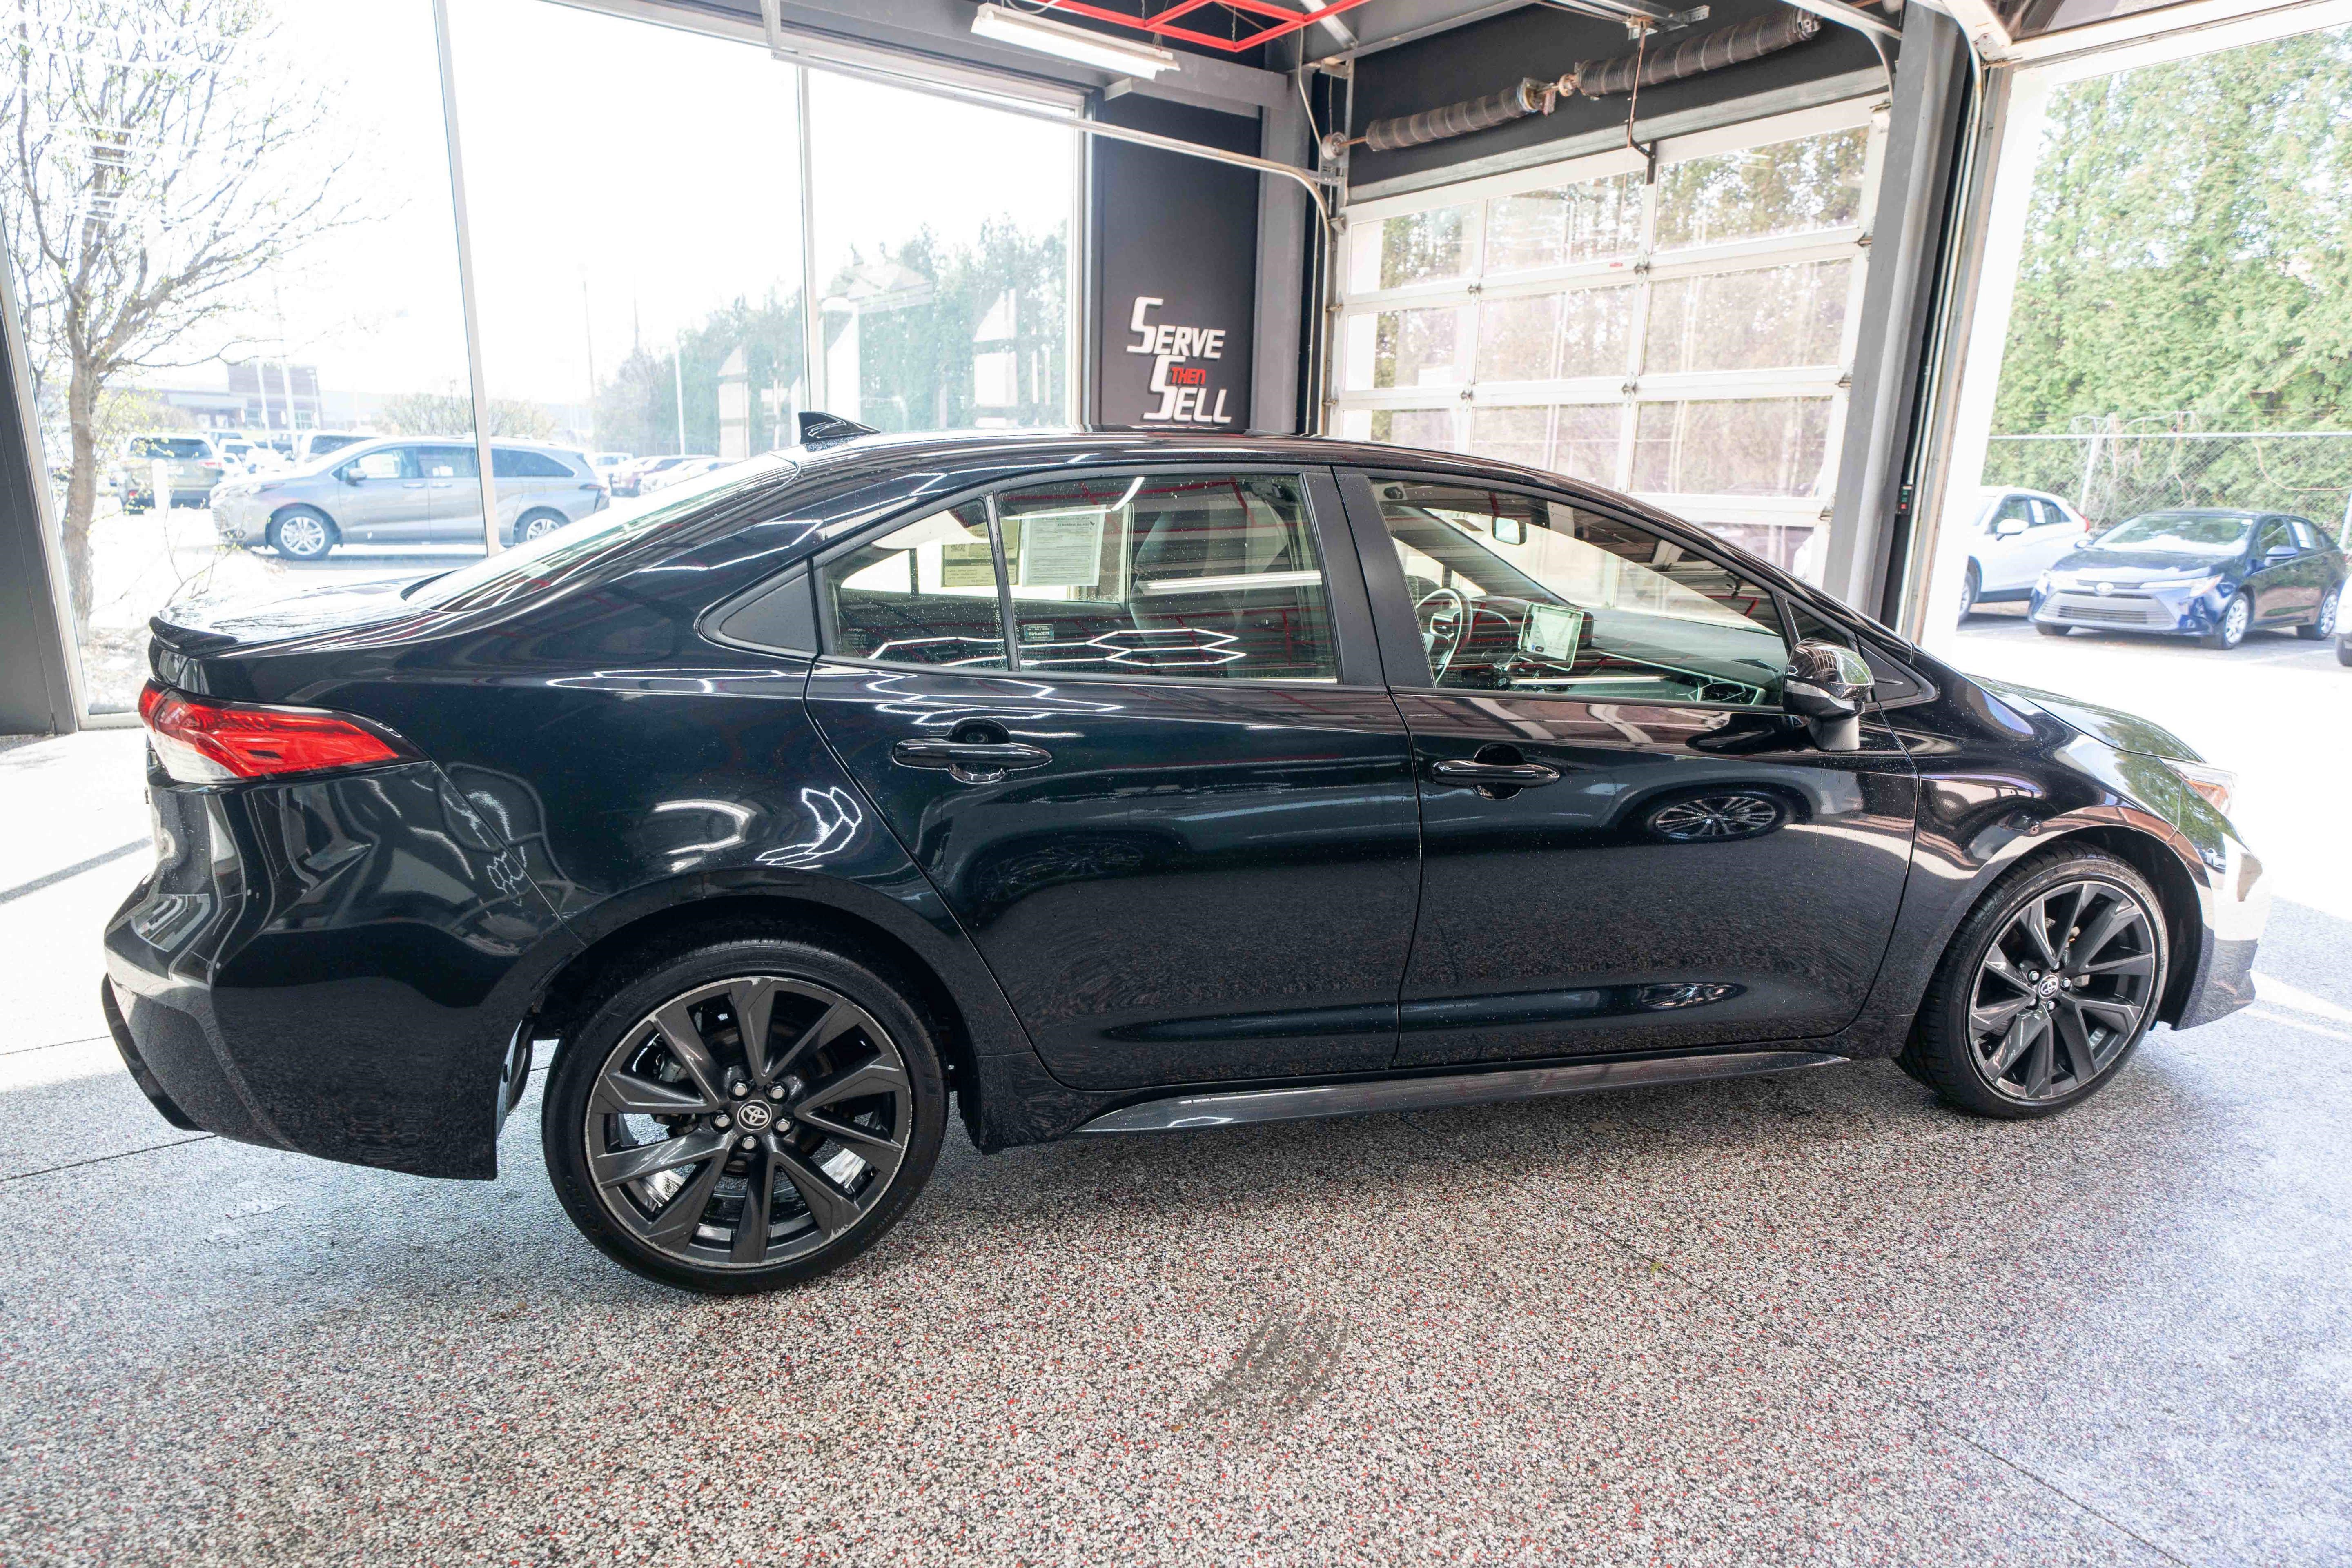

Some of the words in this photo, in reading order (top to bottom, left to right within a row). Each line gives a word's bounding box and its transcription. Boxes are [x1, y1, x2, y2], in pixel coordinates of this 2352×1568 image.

[1126, 296, 1226, 359] SERVE
[1143, 354, 1232, 423] SELL
[1171, 367, 1206, 385] THEN
